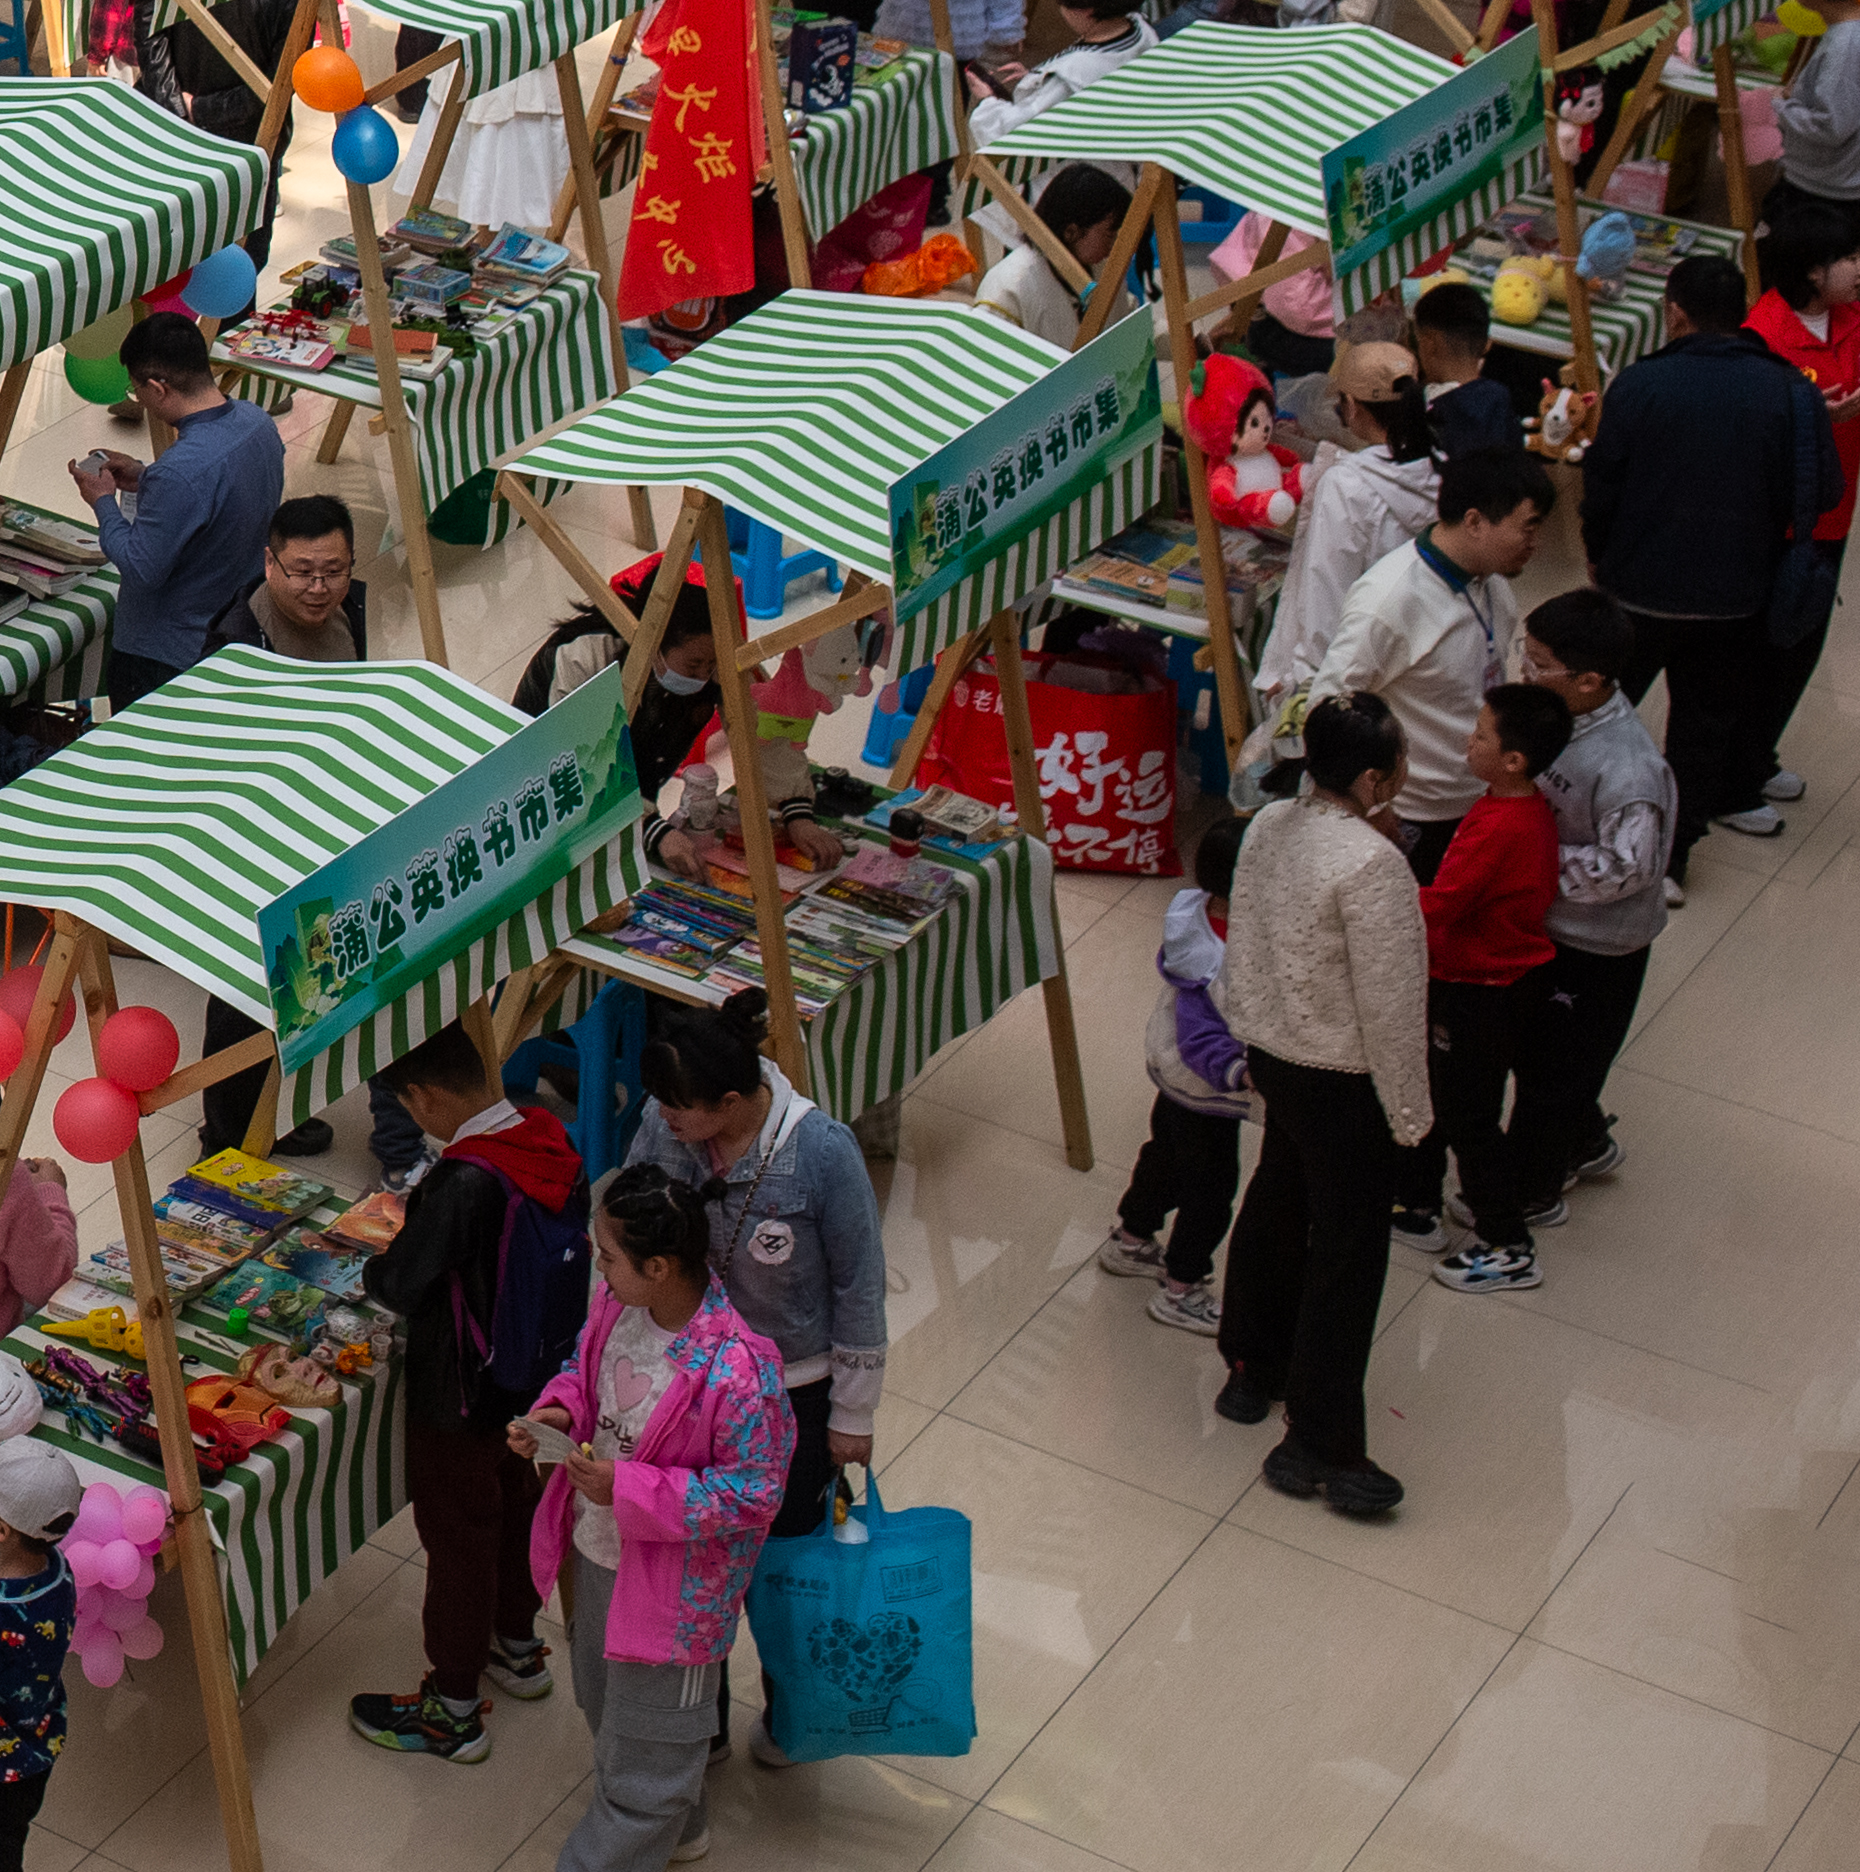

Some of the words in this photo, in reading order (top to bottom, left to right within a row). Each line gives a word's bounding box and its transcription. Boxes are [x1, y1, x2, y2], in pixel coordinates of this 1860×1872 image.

[935, 377, 1120, 551] 蒲公英换书市集
[1035, 731, 1172, 825] 好运
[329, 752, 585, 980] 蒲公英换书市集
